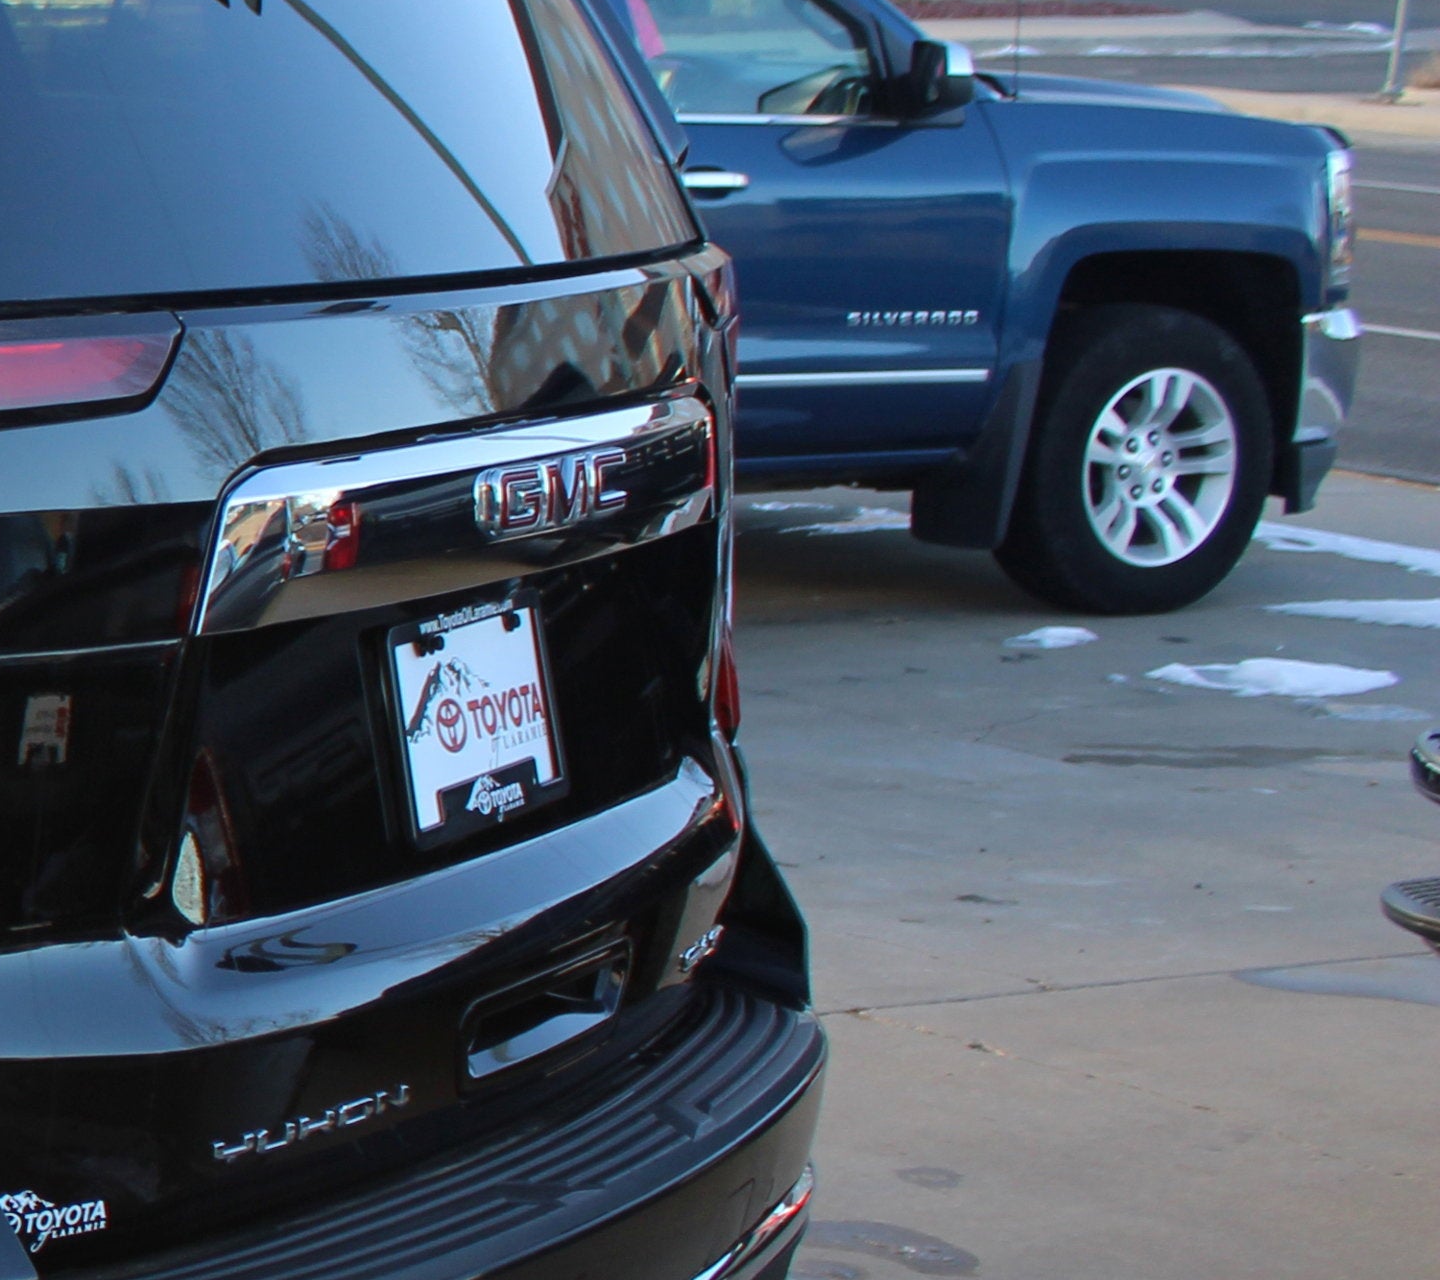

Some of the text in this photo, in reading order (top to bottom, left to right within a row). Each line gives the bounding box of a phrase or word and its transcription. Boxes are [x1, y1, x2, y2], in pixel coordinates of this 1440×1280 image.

[845, 309, 980, 327] SILVERADO
[475, 447, 628, 536] GMC
[466, 682, 547, 741] TOYOTA
[213, 1084, 411, 1163] YUKON
[24, 1199, 107, 1234] TOYOTA
[51, 1220, 107, 1239] LARAMIE
